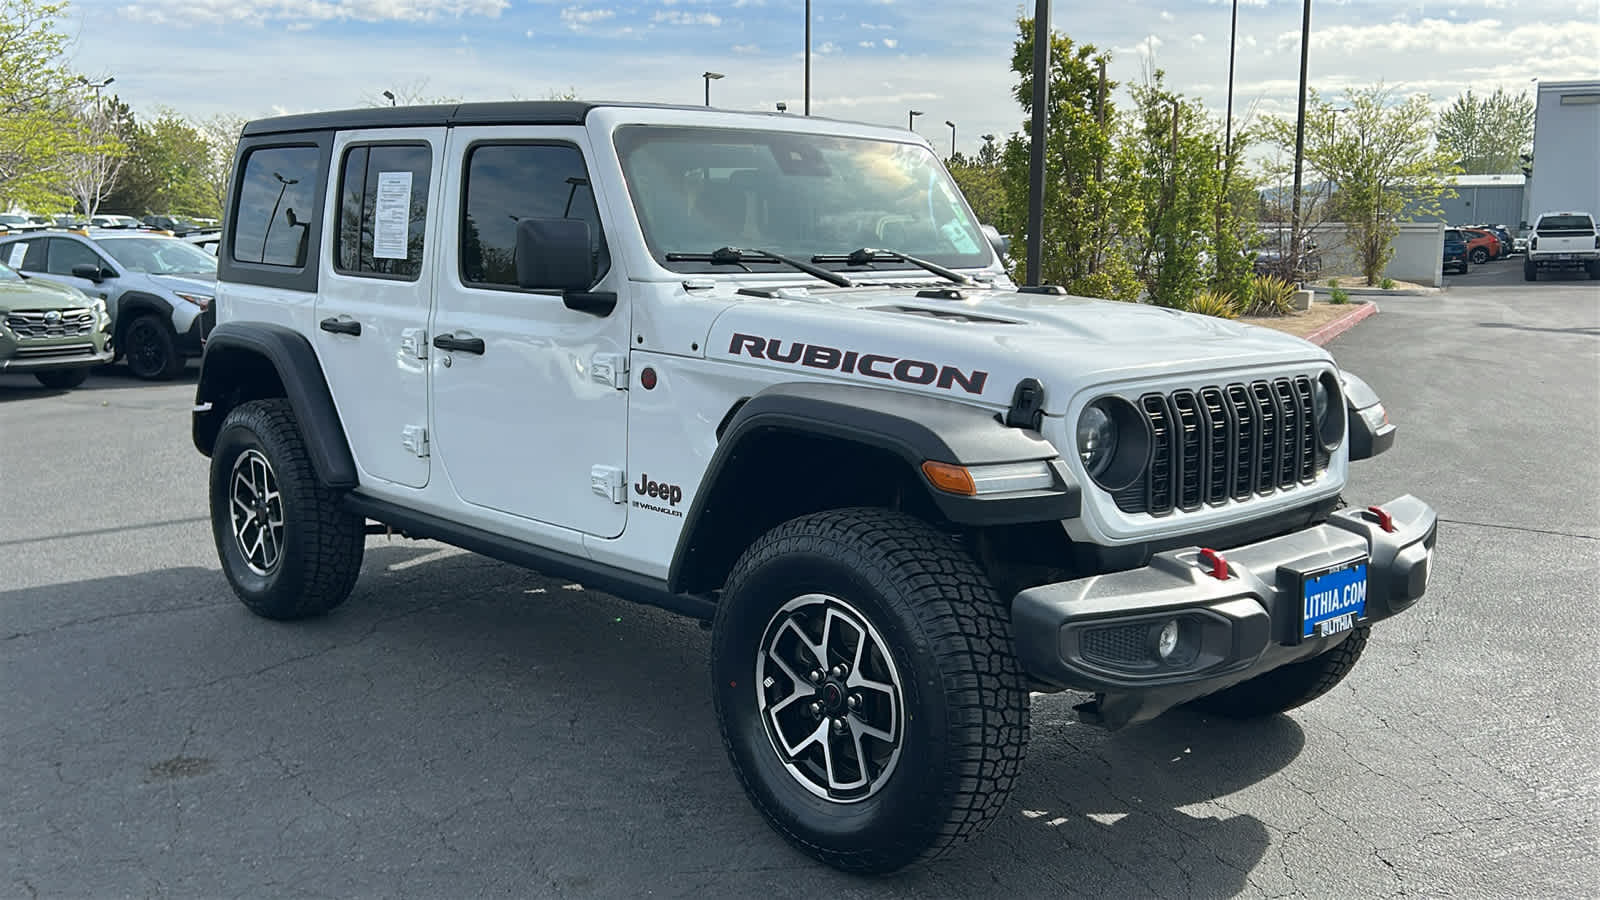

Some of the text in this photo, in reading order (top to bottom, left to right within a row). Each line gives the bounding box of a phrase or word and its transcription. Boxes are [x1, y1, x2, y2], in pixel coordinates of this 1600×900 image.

[728, 333, 989, 395] RUBICON
[634, 473, 682, 506] Jeep
[639, 502, 683, 517] WRANGLER
[1303, 579, 1367, 621] LITHIA.COM
[1328, 614, 1353, 635] LITHIA
